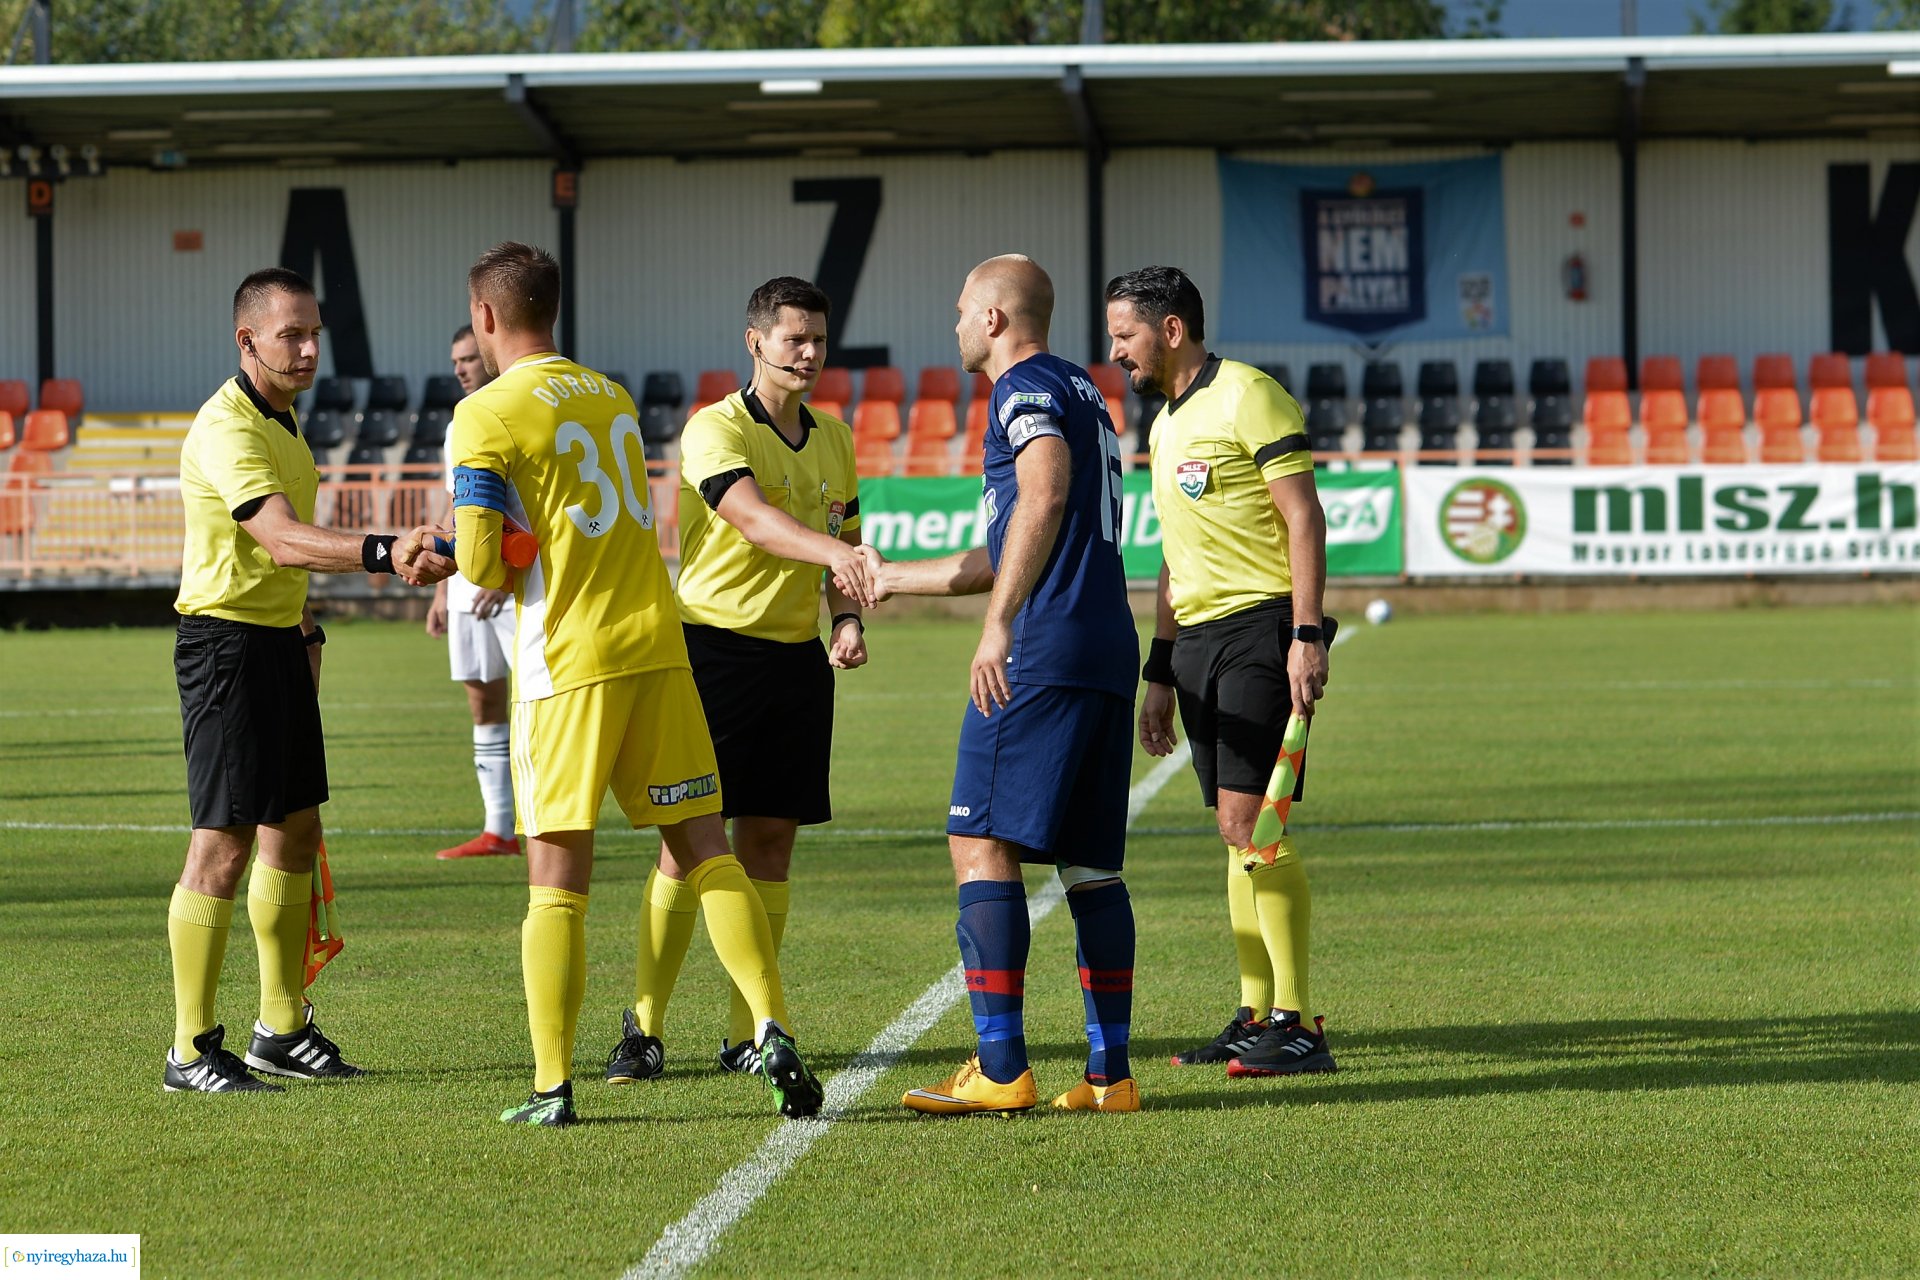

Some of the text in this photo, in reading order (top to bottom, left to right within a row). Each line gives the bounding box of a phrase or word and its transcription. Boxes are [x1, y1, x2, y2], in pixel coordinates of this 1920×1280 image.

[793, 177, 890, 368] Z
[1828, 162, 1920, 355] K
[1318, 226, 1409, 273] NEM
[532, 373, 617, 408] DOROG
[1019, 415, 1038, 439] C
[555, 413, 655, 538] 30
